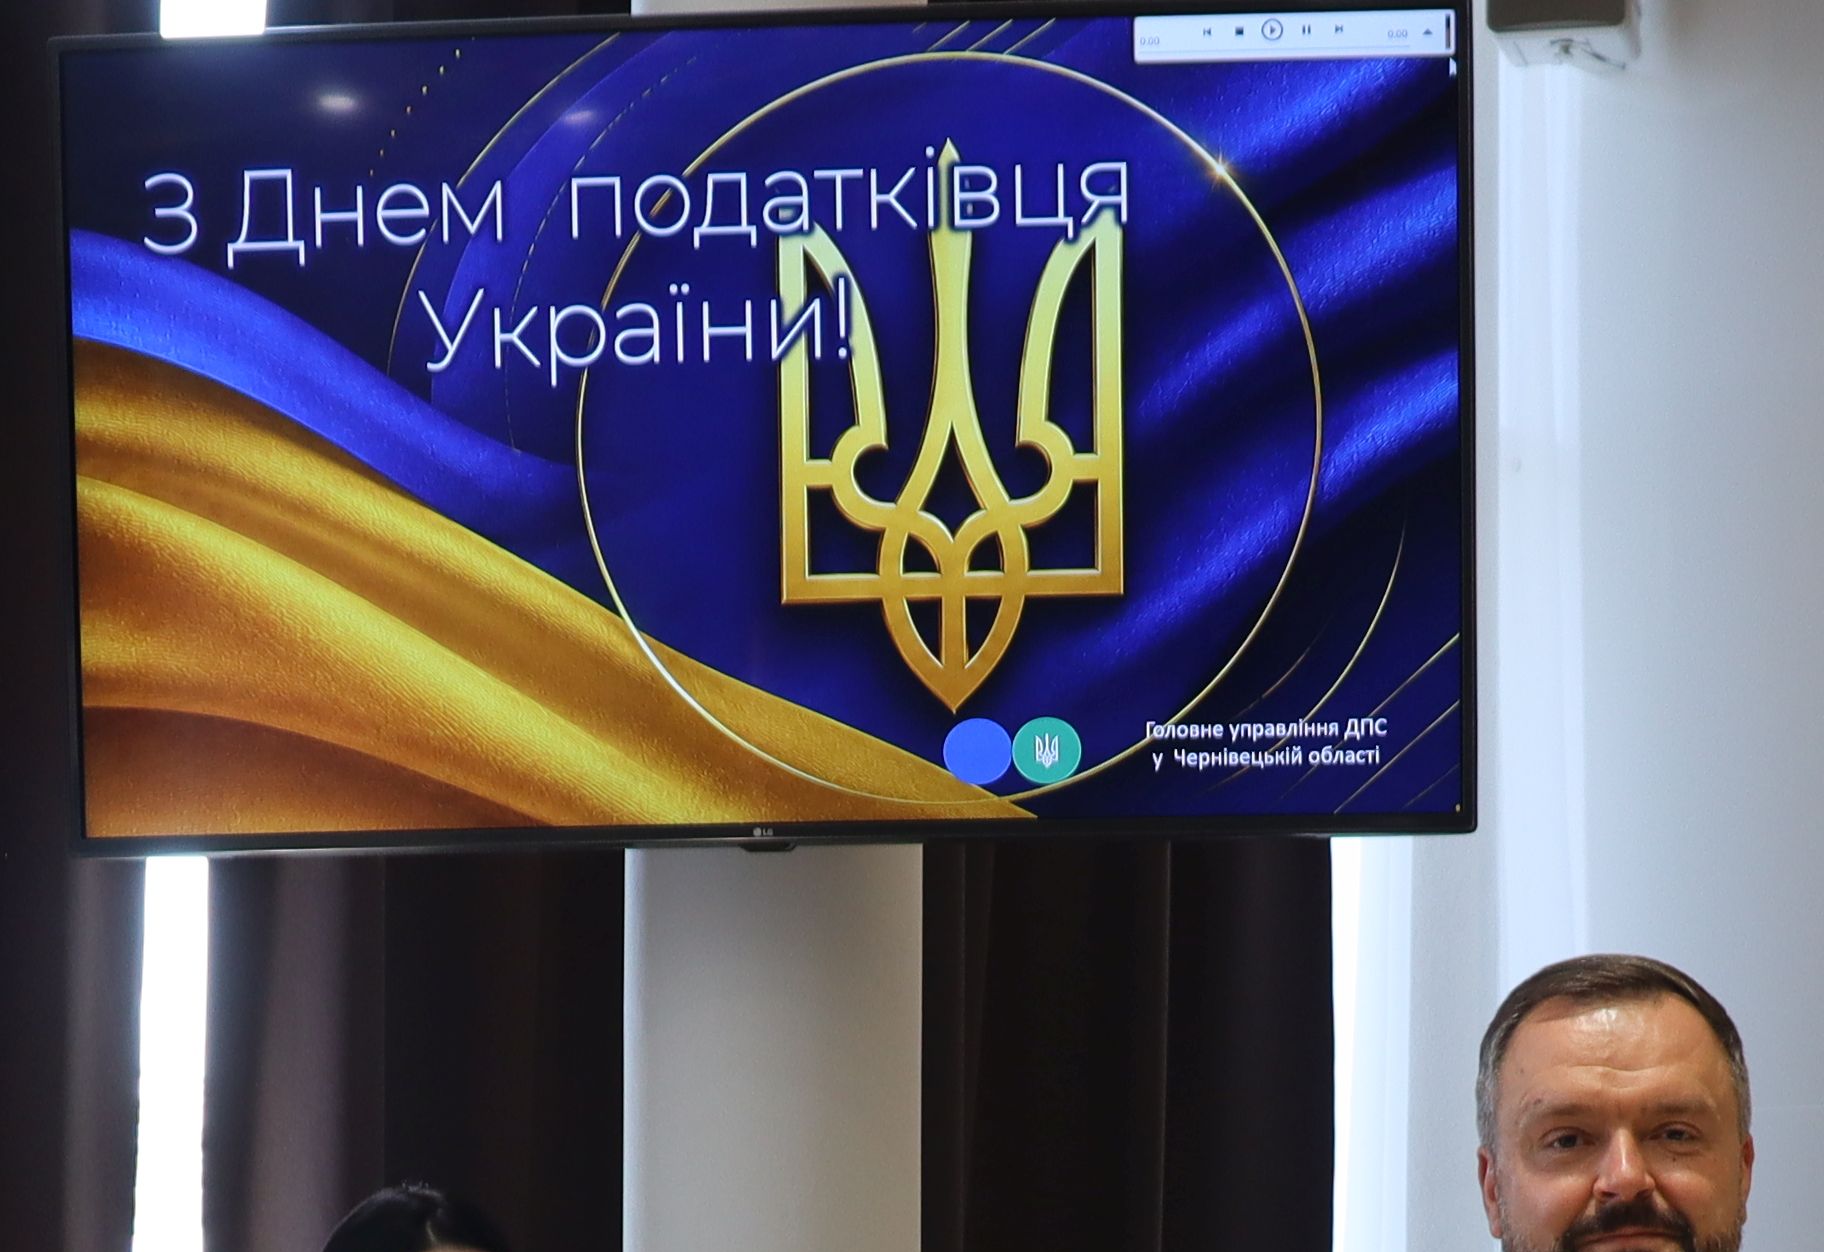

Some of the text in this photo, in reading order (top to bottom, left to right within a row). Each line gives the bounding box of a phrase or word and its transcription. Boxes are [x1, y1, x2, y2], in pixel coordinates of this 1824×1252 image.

[227, 168, 504, 270] Днем
[570, 145, 1128, 249] податківця
[418, 276, 850, 389] України!
[1146, 718, 1388, 742] Головне управління ДПС
[1152, 745, 1380, 771] у Чернівецькій області
